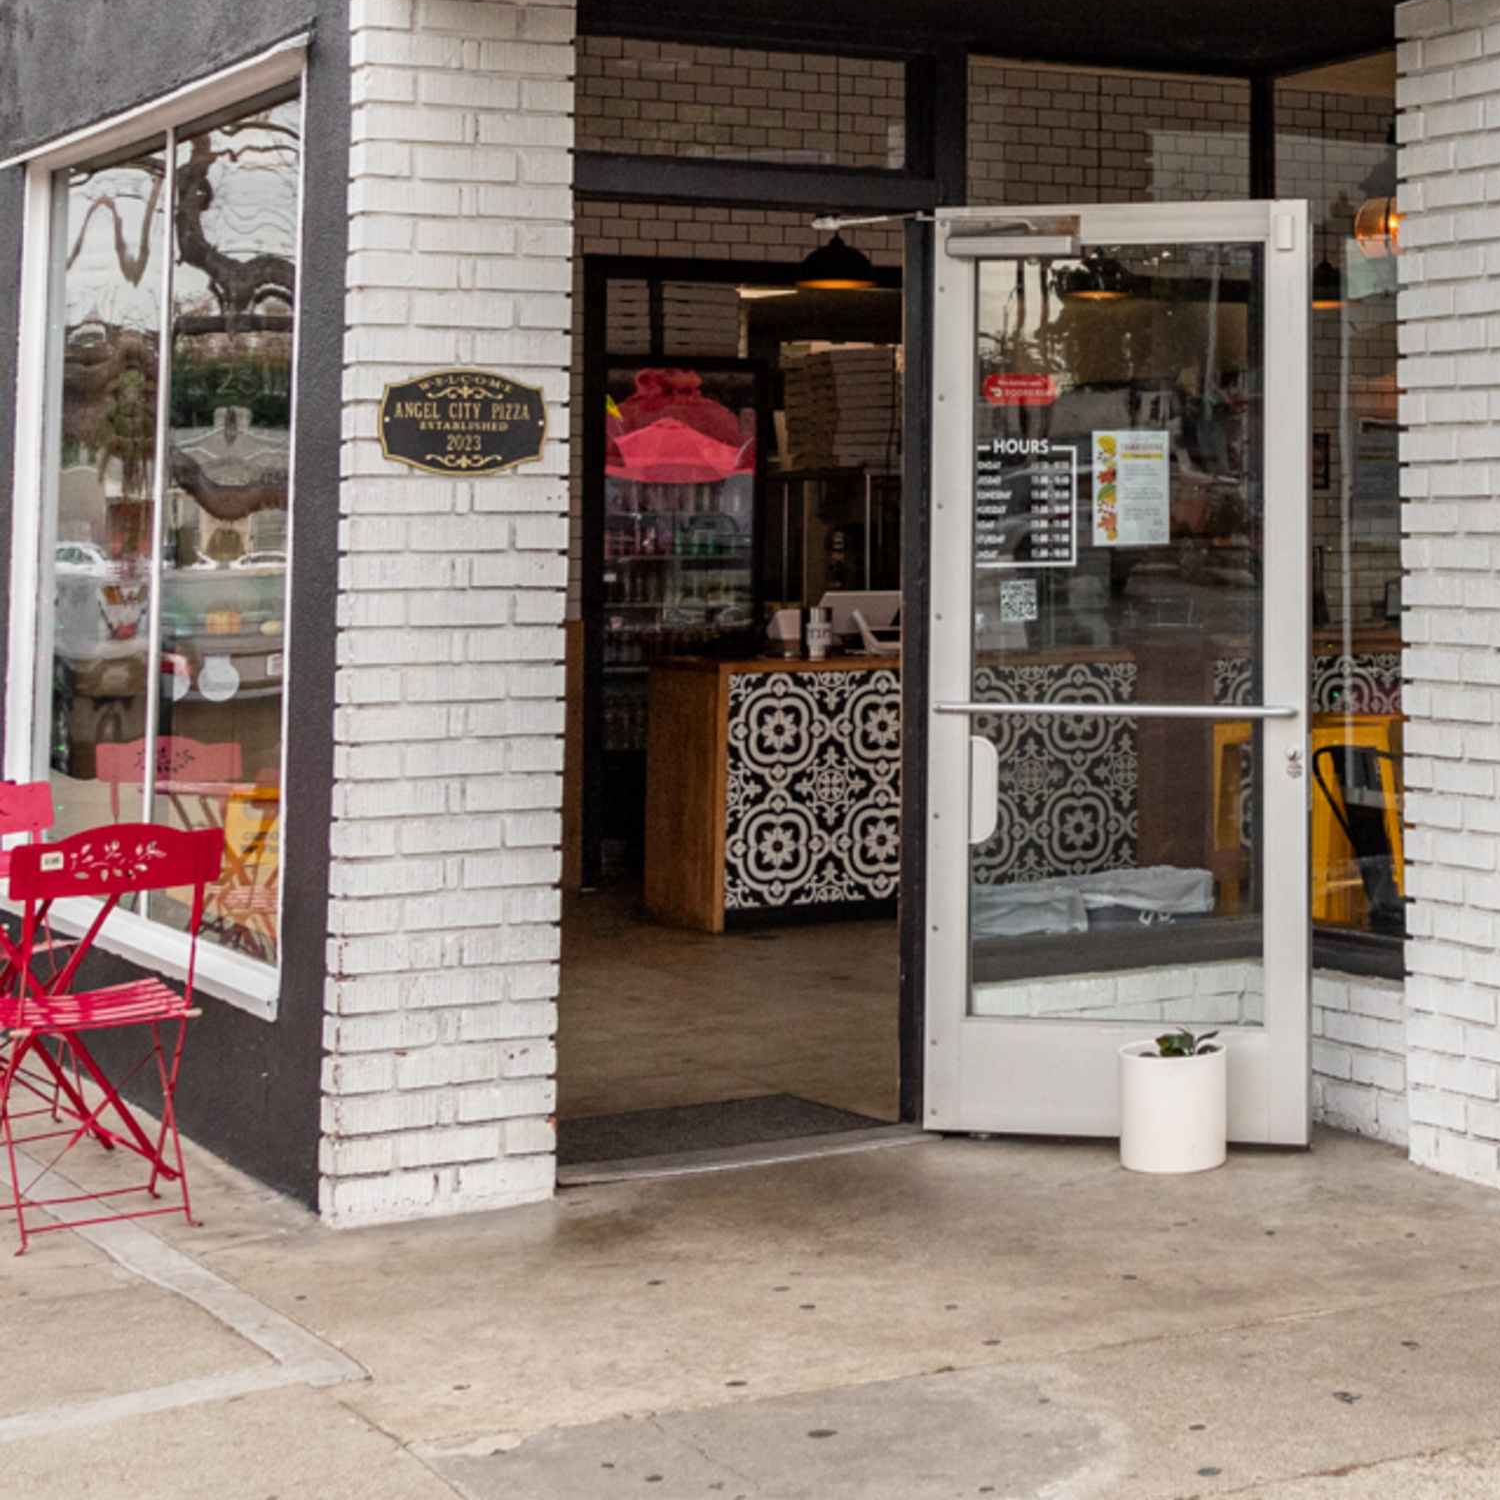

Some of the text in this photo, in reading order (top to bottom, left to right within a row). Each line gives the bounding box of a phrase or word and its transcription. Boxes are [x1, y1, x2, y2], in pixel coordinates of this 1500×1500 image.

[394, 402, 531, 421] ANGEL CITY PIZZA
[419, 421, 509, 432] ESTABLISHED
[447, 433, 482, 451] 2023
[993, 439, 1050, 455] HOURS
